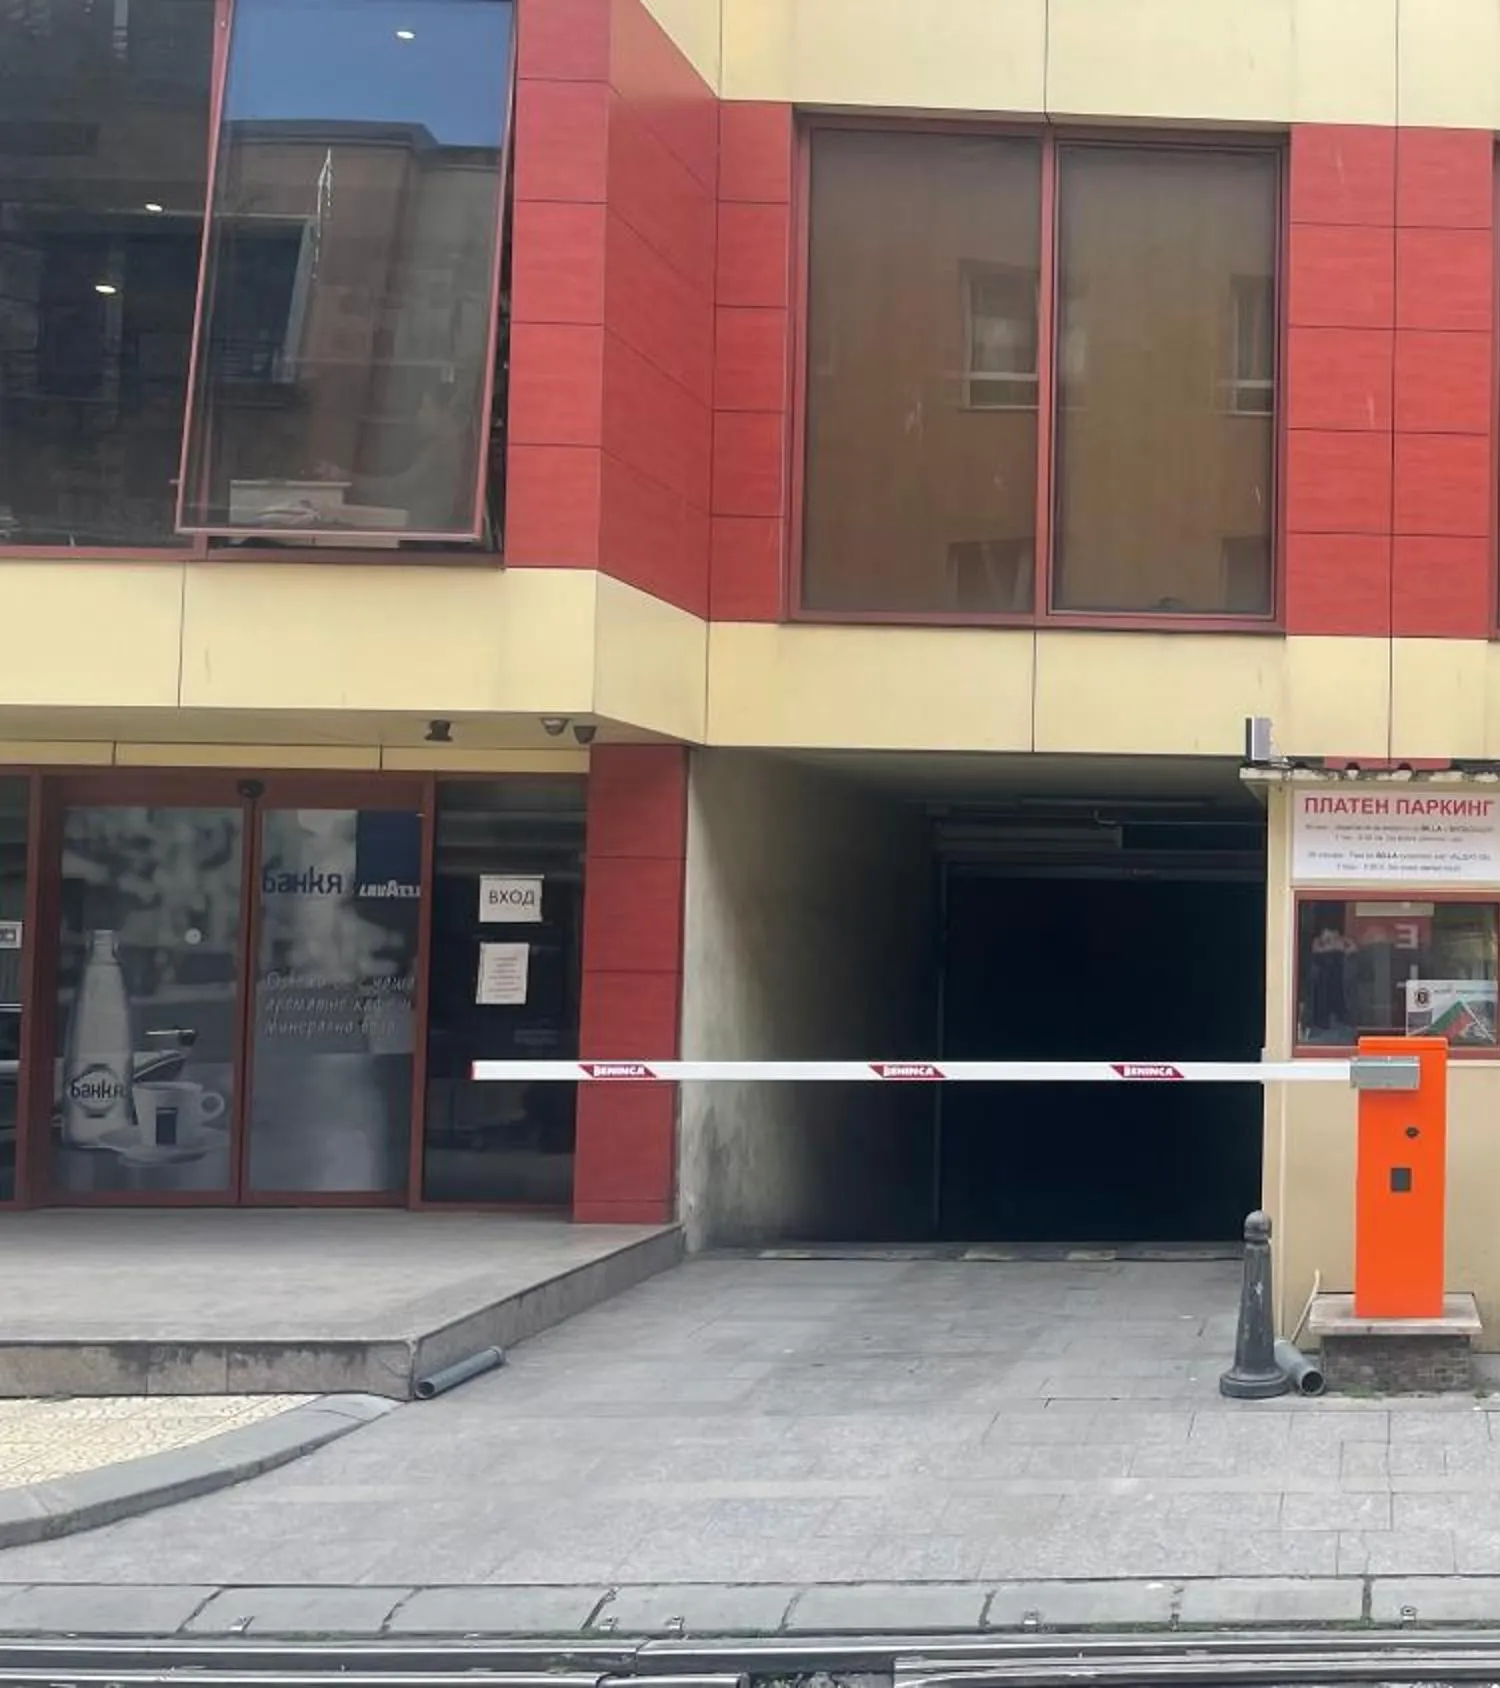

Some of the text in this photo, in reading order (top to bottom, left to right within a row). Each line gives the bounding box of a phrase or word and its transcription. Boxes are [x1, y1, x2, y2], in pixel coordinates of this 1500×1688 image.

[1304, 797, 1496, 817] ПЛАТЕН ПАРКИНГ
[488, 889, 535, 906] ВХОД
